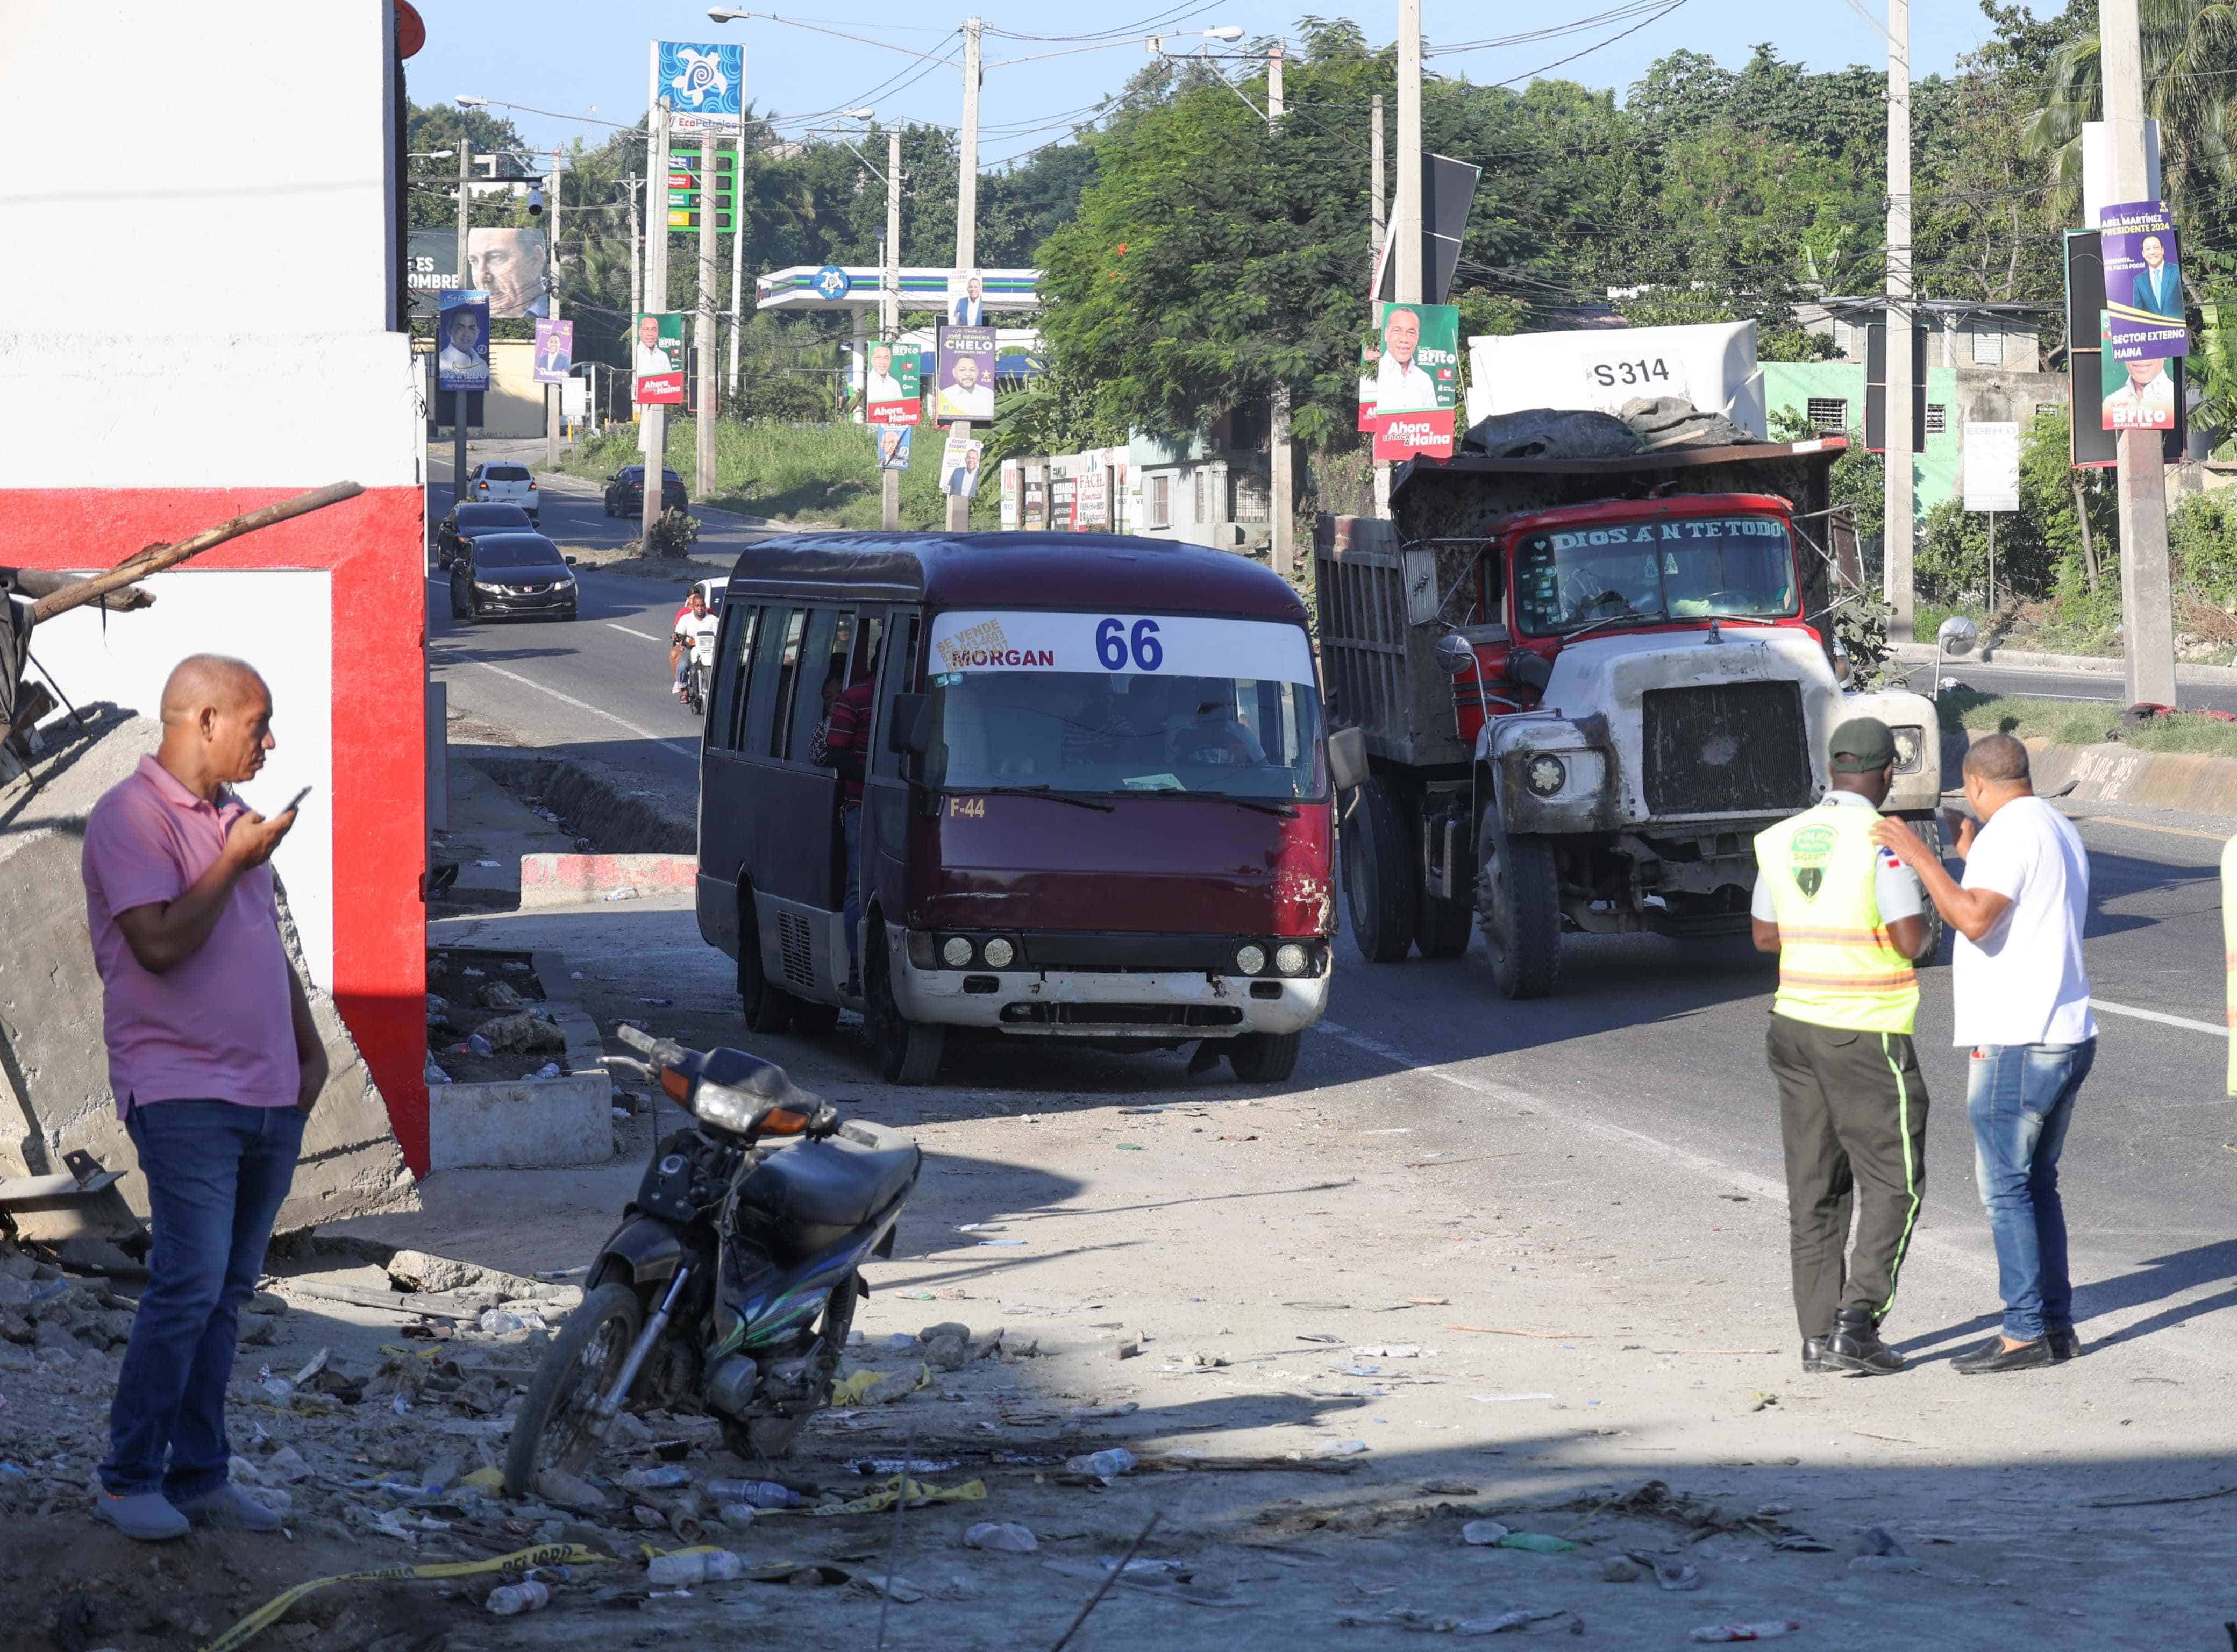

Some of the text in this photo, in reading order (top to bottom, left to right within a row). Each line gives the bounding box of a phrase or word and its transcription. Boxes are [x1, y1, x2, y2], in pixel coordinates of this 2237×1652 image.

[2102, 223, 2170, 237] PRESIDENTE 2024
[2112, 329, 2185, 345] SECTOR EXTERNO
[944, 340, 993, 351] CHELO
[1418, 350, 1456, 364] Brito
[2114, 347, 2142, 359] HAINA
[873, 407, 903, 416] Ahora
[889, 412, 917, 422] Haina
[2113, 408, 2167, 423] Brito
[1387, 421, 1430, 435] Ahora
[1410, 431, 1451, 446] Haina
[1080, 474, 1105, 488] FACIL
[1554, 528, 1628, 551] DIOS
[1725, 521, 1782, 538] TODO
[937, 618, 999, 652] SE VENDE
[1095, 617, 1164, 672] 66
[952, 650, 1053, 666] MORGAN
[950, 798, 985, 818] F-44
